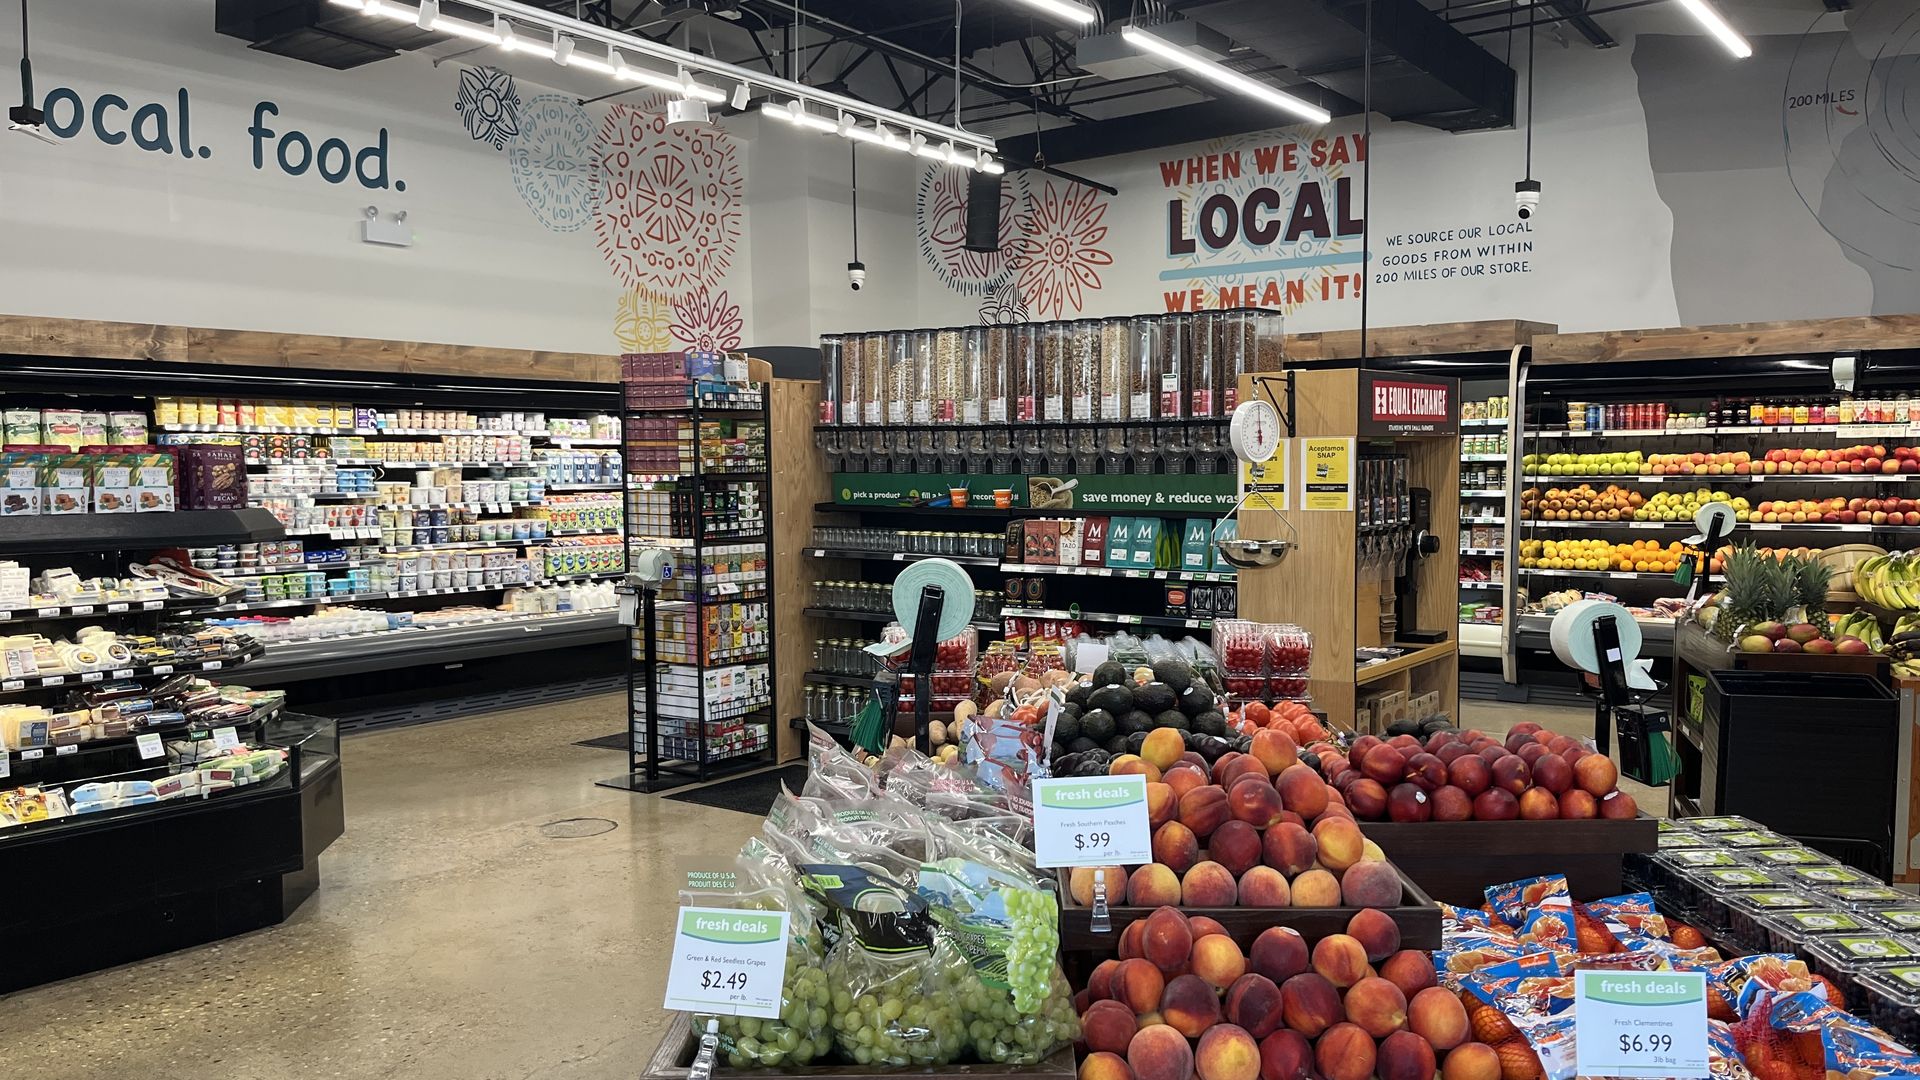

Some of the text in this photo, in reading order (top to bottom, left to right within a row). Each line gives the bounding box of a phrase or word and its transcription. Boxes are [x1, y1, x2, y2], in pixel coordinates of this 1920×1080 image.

[1788, 89, 1856, 109] 200 MILES
[248, 101, 407, 193] food.
[1159, 133, 1369, 188] WHEN WE SAY
[1166, 176, 1364, 258] LOCAL
[1386, 221, 1533, 246] WE SOURCE OUR LOCAL
[1382, 241, 1533, 267] GOODS FROM WITHIN
[1375, 261, 1532, 284] 200 MILES OF OUR STORE.
[1163, 272, 1362, 313] WE MEAN IT!
[1389, 386, 1446, 416] EQUAL EXCHANGE
[1308, 445, 1345, 453] Aceptamos
[853, 491, 867, 500] pick
[874, 491, 900, 500] product
[1082, 493, 1108, 503] save
[1110, 493, 1152, 506] money
[1155, 492, 1165, 503] &
[1169, 492, 1214, 503] reduce
[1055, 787, 1130, 801] fresh deals
[1077, 820, 1102, 828] Southern
[1074, 832, 1110, 851] $.99
[687, 871, 712, 879] PRODUCE
[695, 917, 768, 934] fresh deals
[686, 954, 704, 962] Green
[711, 955, 721, 963] Red
[722, 956, 745, 965] Seedless
[746, 958, 766, 967] Grapes
[701, 970, 747, 990] $2.49
[1600, 980, 1687, 994] fresh deals
[1633, 1019, 1673, 1027] Clementines
[1619, 1034, 1672, 1054] $6.99
